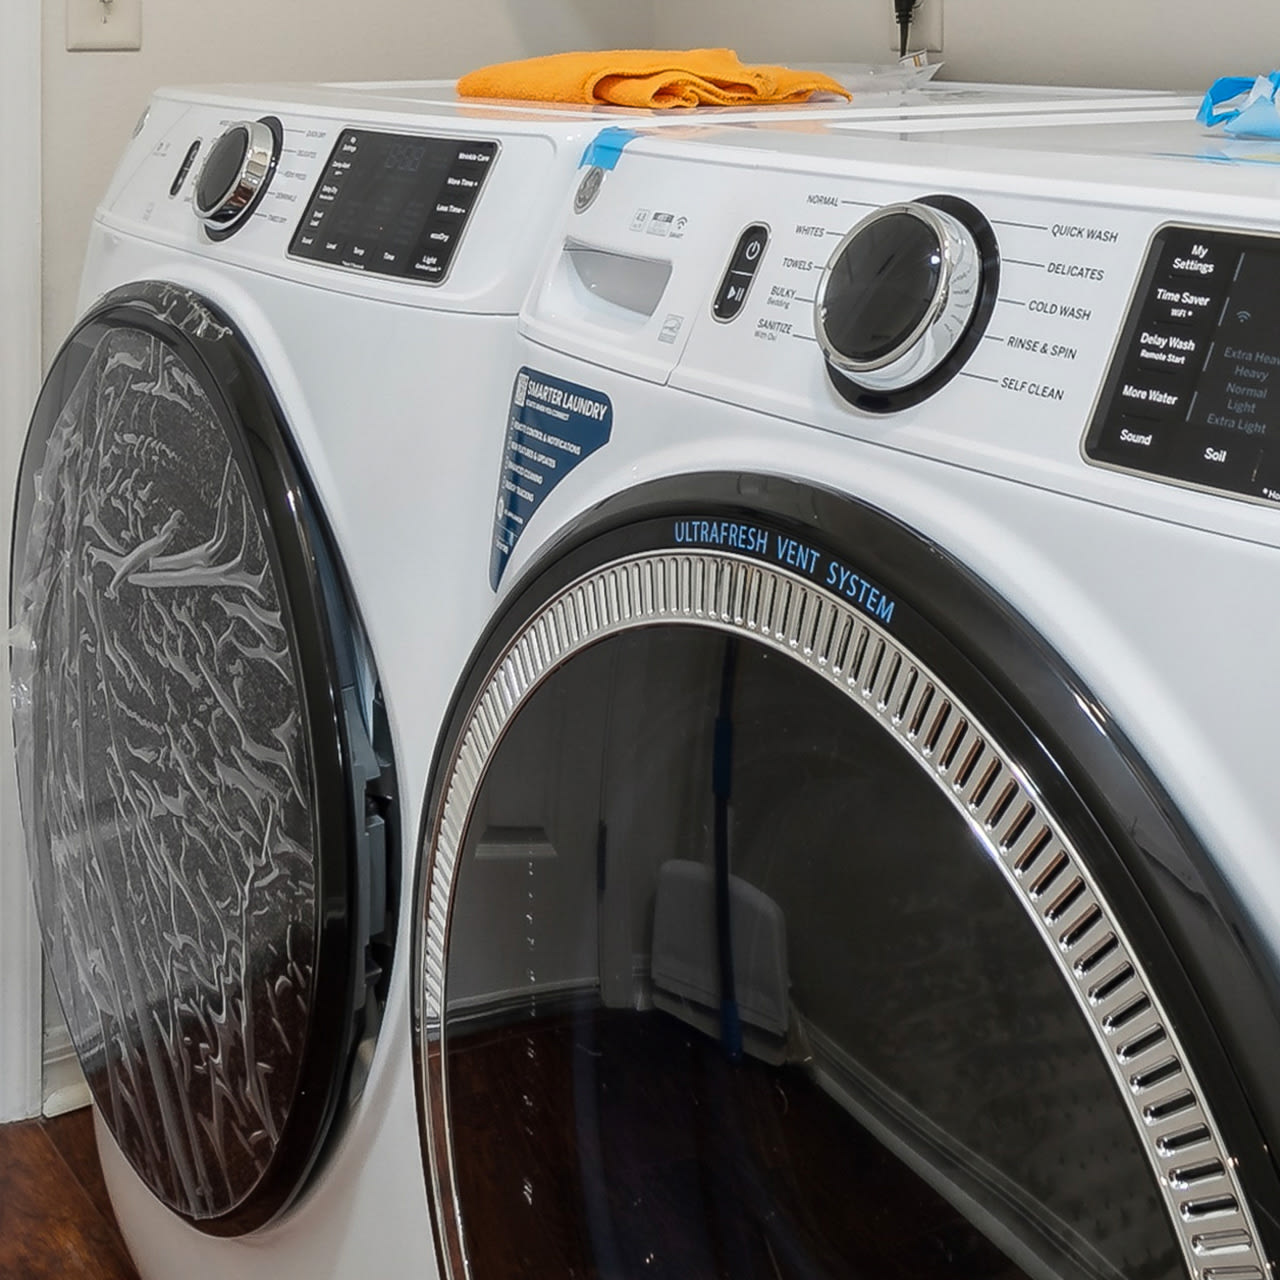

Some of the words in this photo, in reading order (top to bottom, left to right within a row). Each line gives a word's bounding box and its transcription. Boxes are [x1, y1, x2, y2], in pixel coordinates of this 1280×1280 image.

[806, 194, 839, 207] NORMAL
[795, 225, 825, 238] WHITES
[1051, 224, 1085, 238] QUICK
[1086, 229, 1119, 243] WASH
[1191, 244, 1208, 259] My
[782, 257, 813, 271] TOWELS
[1047, 262, 1105, 281] DELICATES
[1172, 257, 1215, 274] Settings
[770, 285, 796, 299] BULKY
[1156, 288, 1179, 302] Time
[1181, 292, 1210, 306] Saver
[1028, 300, 1058, 315] COLD
[1060, 306, 1091, 321] WASH
[757, 318, 792, 334] SANITIZE
[1007, 336, 1040, 353] RINSE
[1040, 343, 1048, 354] &
[1050, 345, 1078, 360] SPIN
[1140, 332, 1168, 349] Delay
[1169, 336, 1196, 352] Wash
[1140, 349, 1166, 362] Remote
[1166, 353, 1186, 365] Start
[1224, 347, 1253, 362] Extra
[1234, 365, 1269, 382] Heavy
[1001, 377, 1027, 391] SELF
[1028, 383, 1064, 401] CLEAN
[1122, 384, 1147, 399] More
[1149, 389, 1178, 405] Water
[1226, 382, 1268, 399] Normal
[527, 380, 564, 407] SMARTER
[562, 392, 608, 421] LAUNDRY
[1227, 398, 1256, 414] Light
[1207, 413, 1236, 428] Extra
[1237, 419, 1267, 435] Light
[1120, 428, 1153, 446] Sound
[1204, 447, 1227, 463] Soil
[675, 521, 768, 554] ULTRAFRESH
[777, 536, 821, 574] VENT
[826, 561, 896, 624] SYSTEM
